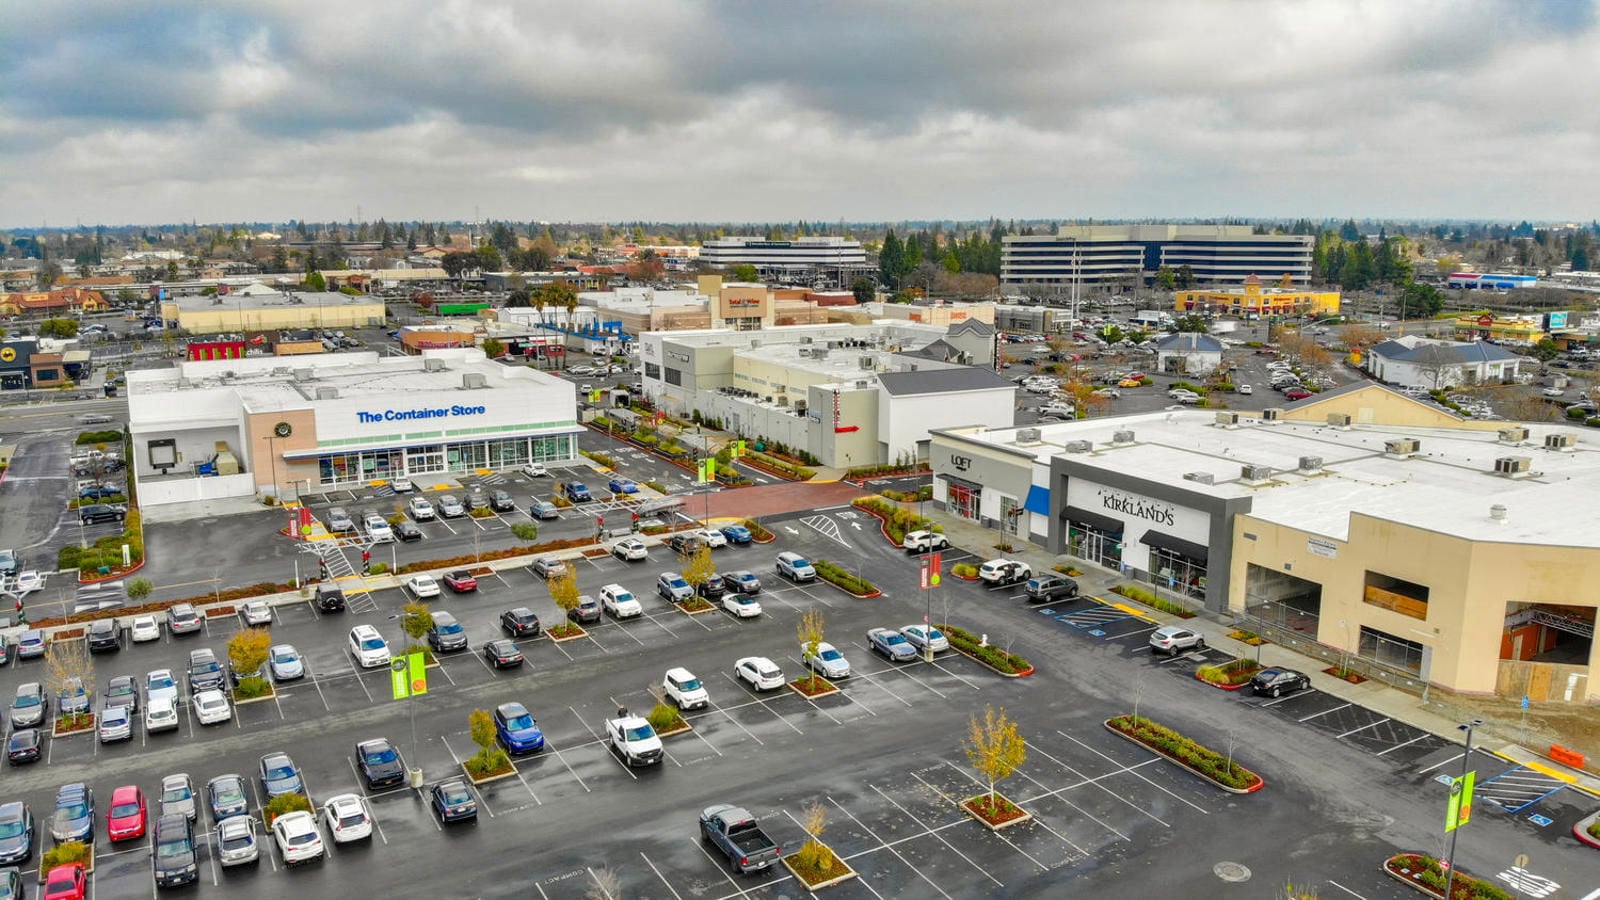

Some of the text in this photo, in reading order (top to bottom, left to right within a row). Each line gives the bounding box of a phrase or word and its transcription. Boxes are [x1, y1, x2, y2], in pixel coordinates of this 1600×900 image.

[357, 405, 486, 423] The Container Store
[950, 454, 972, 469] LOFT
[1103, 494, 1174, 526] KIRKLAND'S
